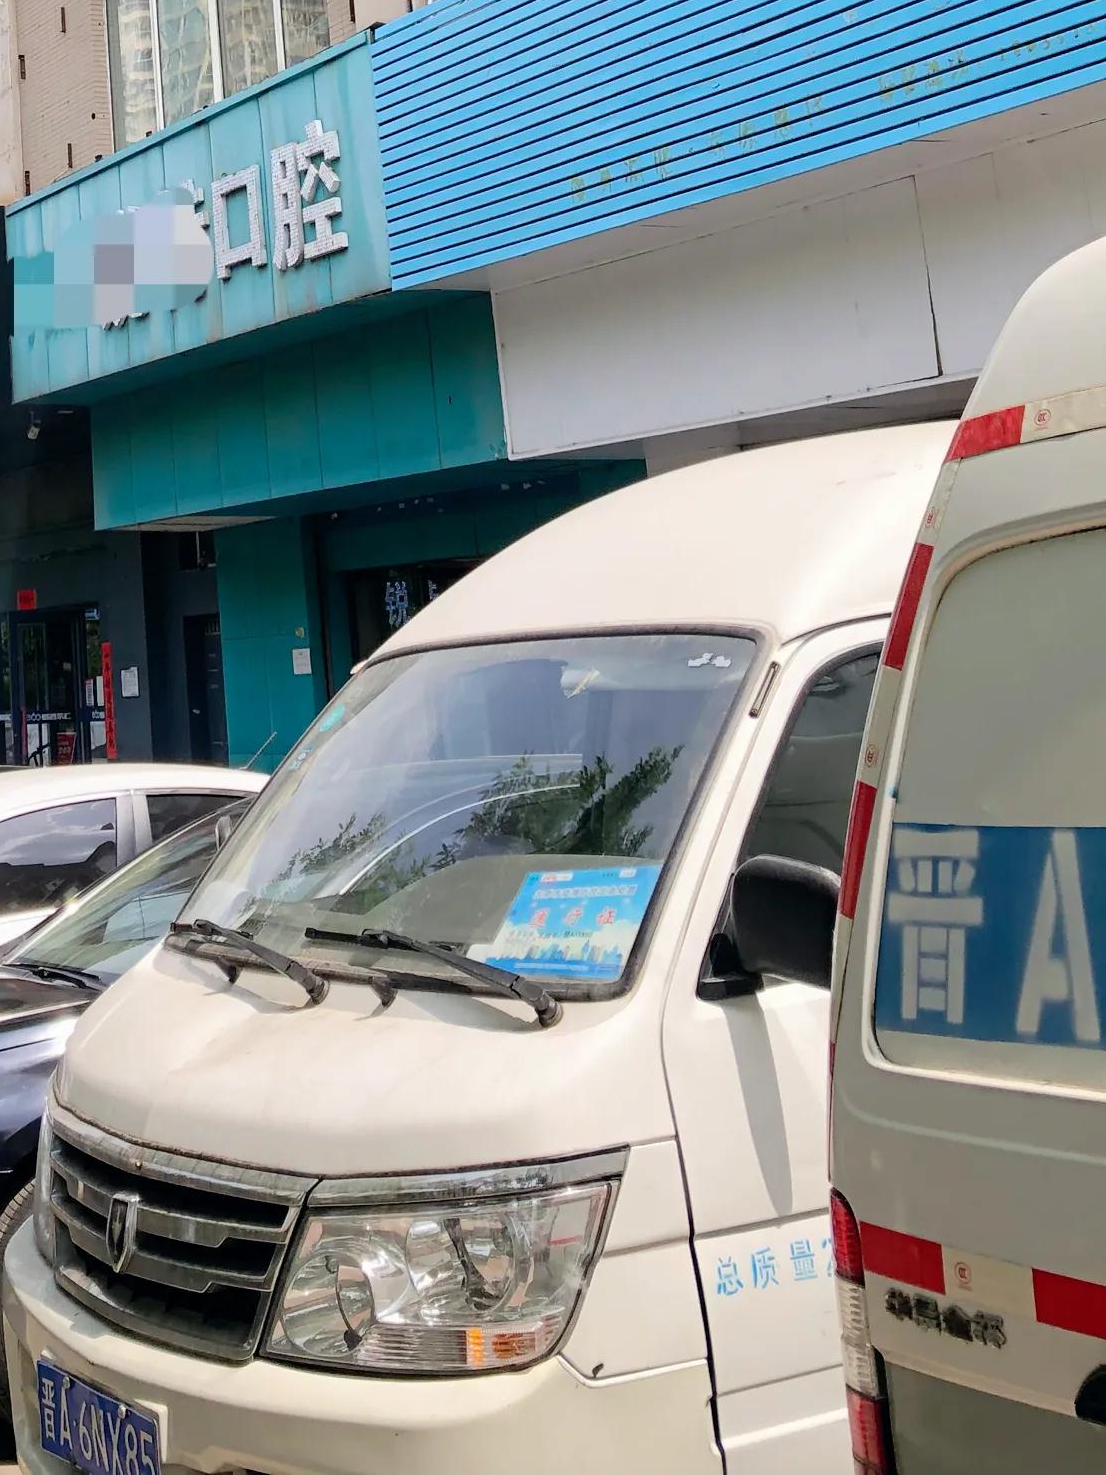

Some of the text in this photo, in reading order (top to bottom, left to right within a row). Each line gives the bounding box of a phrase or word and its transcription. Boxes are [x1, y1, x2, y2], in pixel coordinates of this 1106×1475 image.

[888, 827, 1101, 1042] 晋A
[717, 1237, 833, 1296] 总质量
